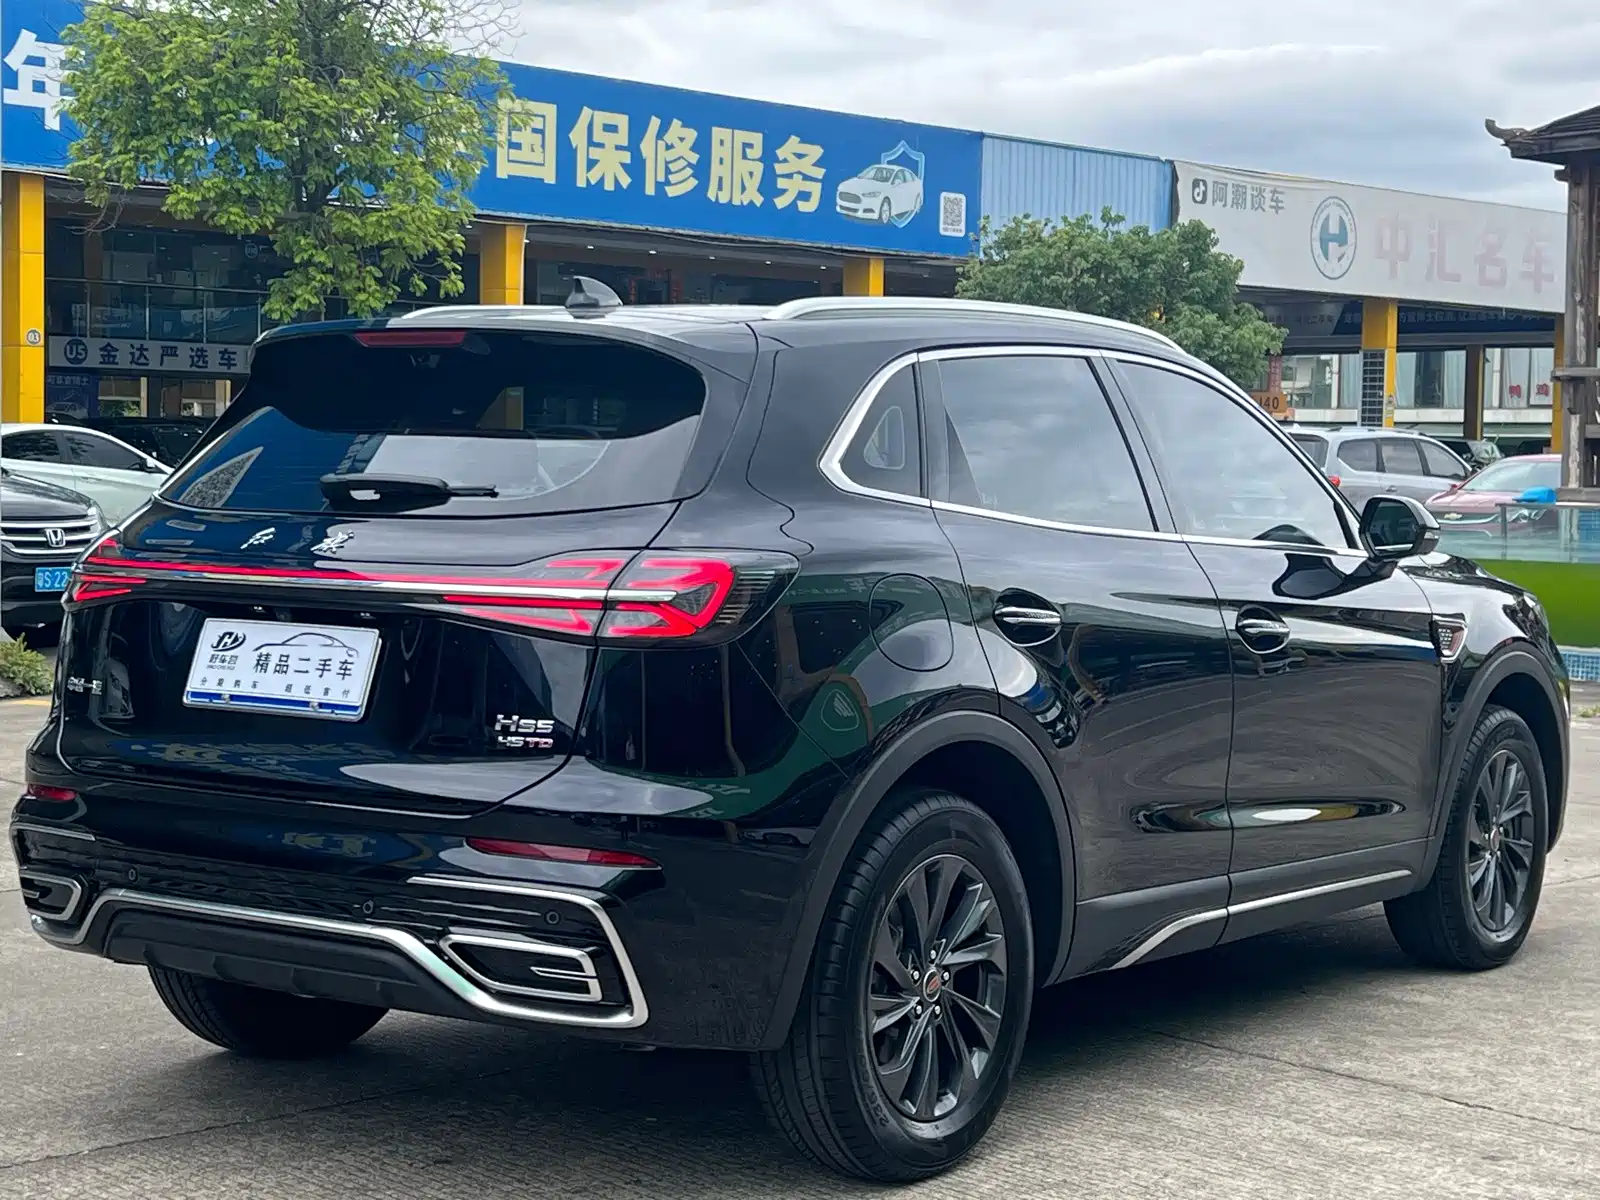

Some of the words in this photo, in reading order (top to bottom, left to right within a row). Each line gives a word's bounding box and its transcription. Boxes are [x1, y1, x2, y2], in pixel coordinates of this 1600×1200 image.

[496, 97, 827, 213] 国保修服务
[1211, 181, 1285, 214] 阿潮谈车
[1374, 211, 1555, 294] 中汇名车
[99, 342, 238, 370] 金达严选车
[253, 652, 355, 681] 精品二手车
[494, 714, 555, 733] HS5
[498, 736, 554, 749] 45TD
